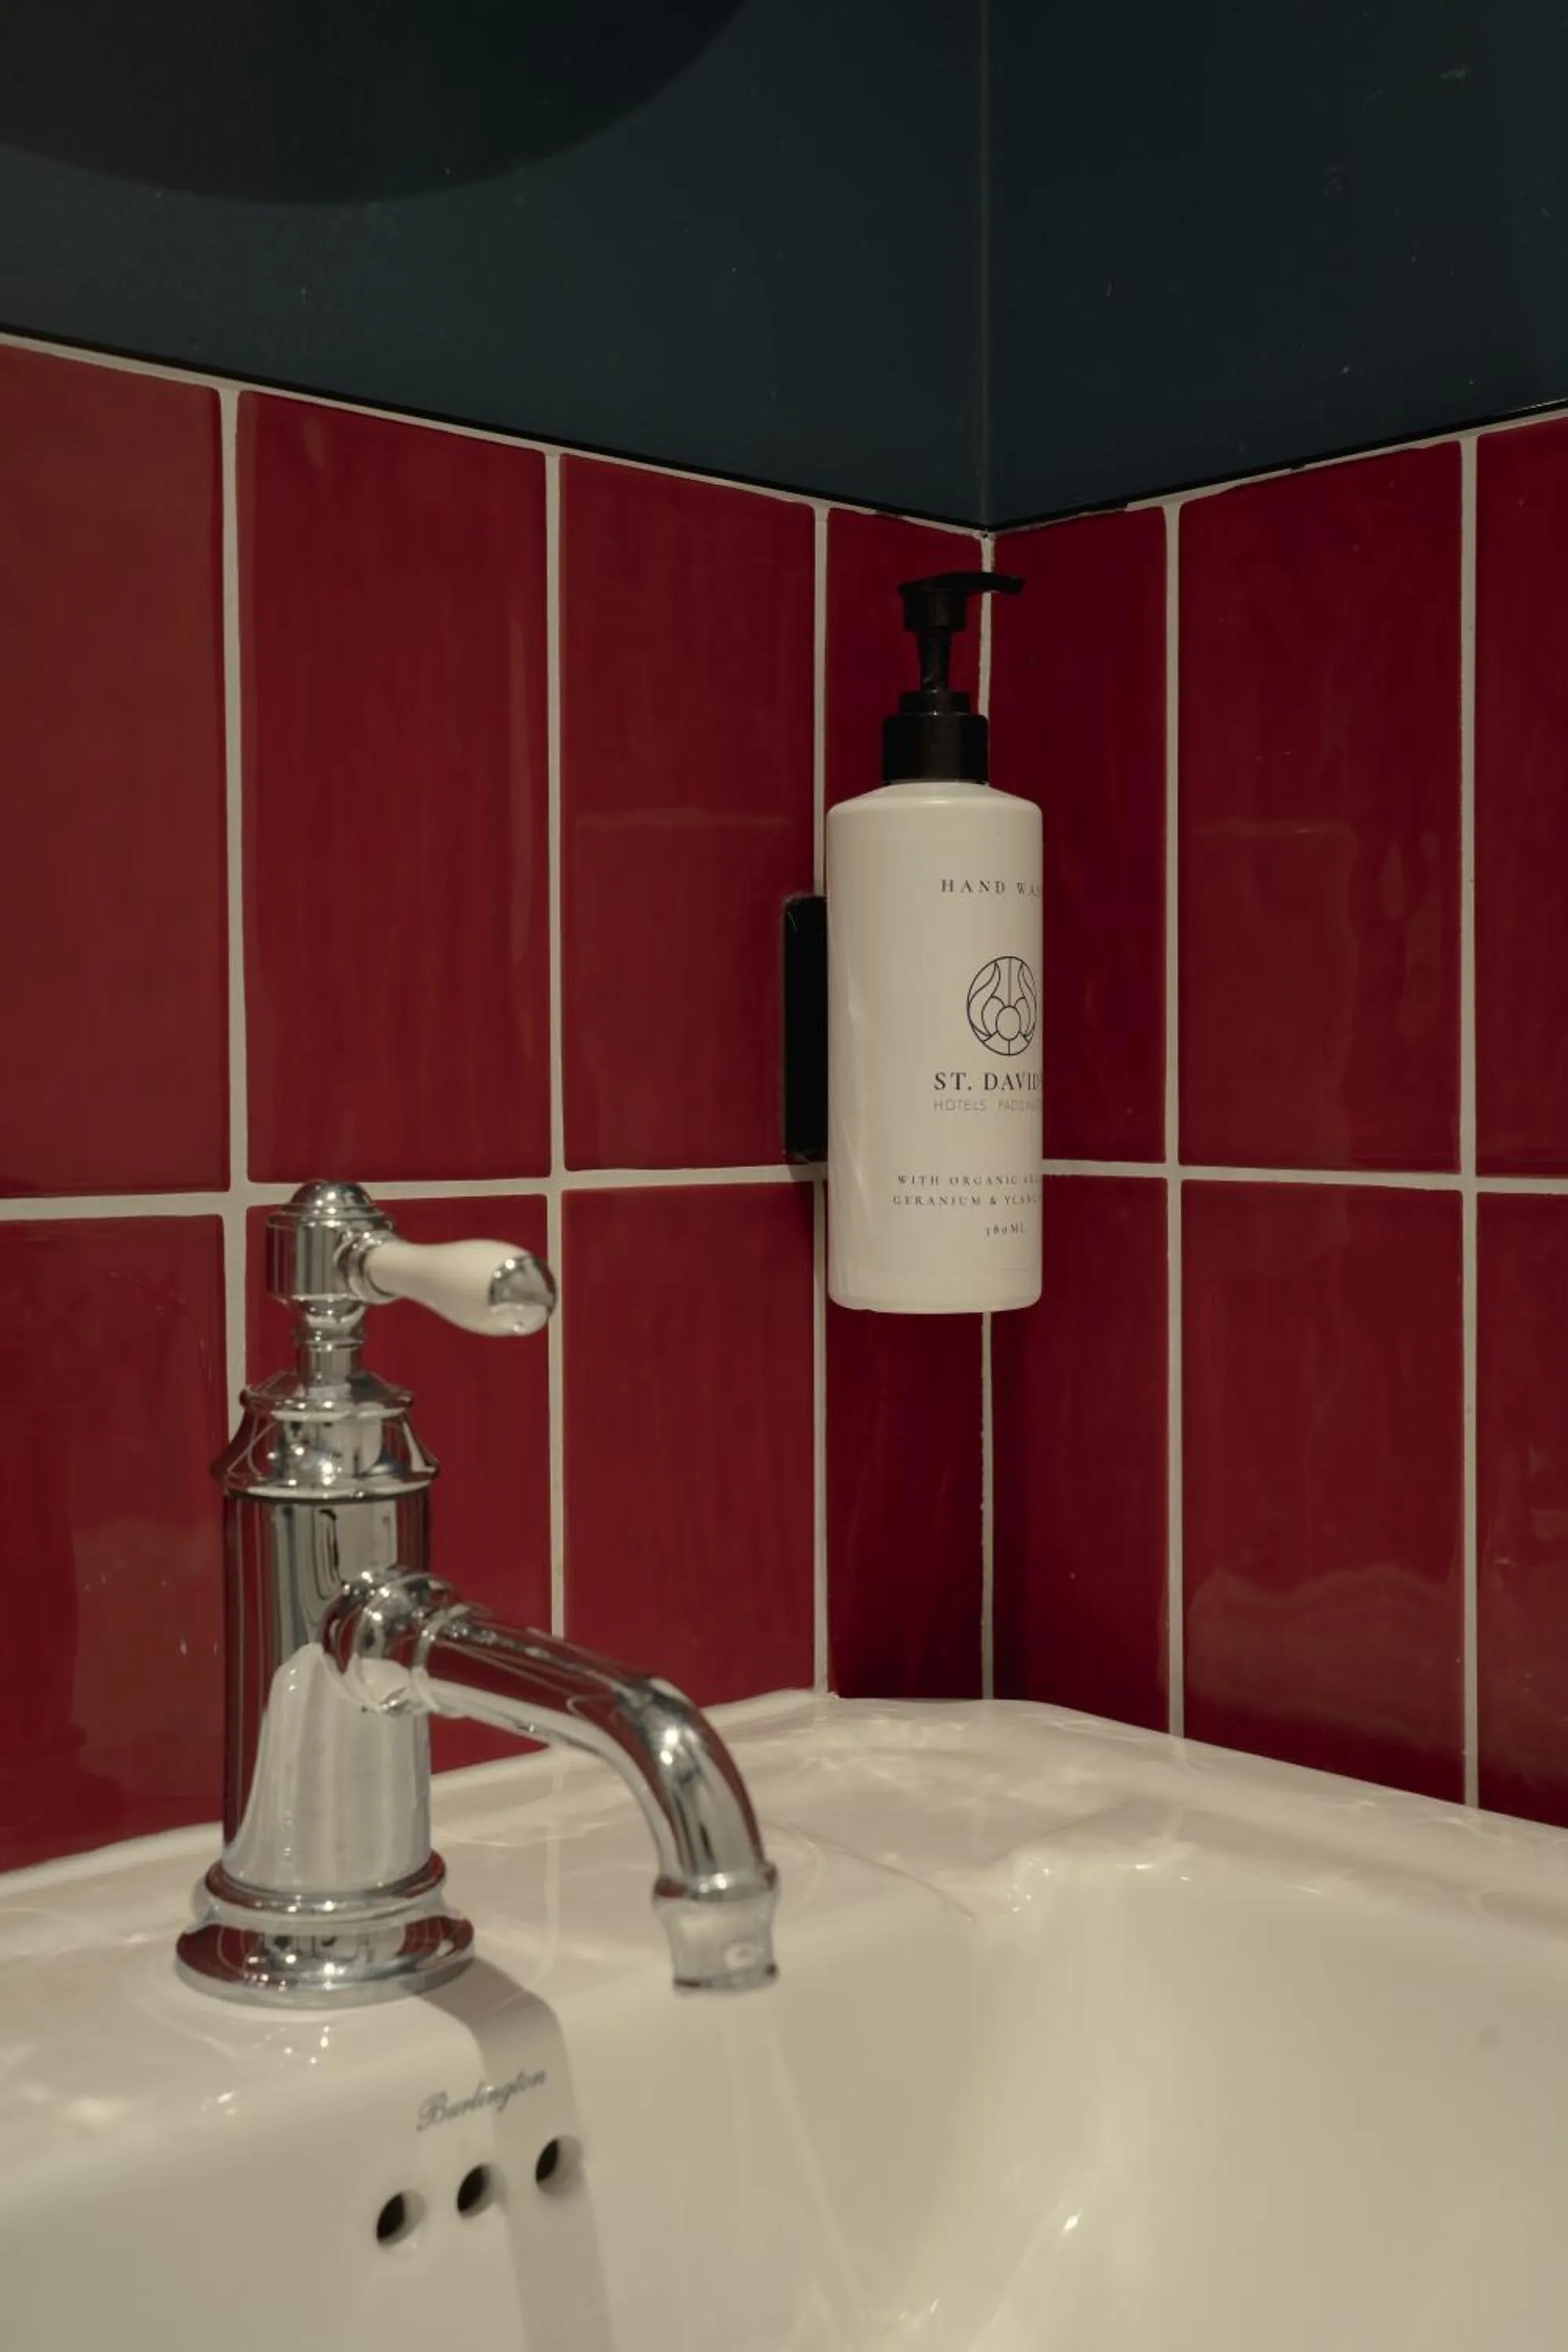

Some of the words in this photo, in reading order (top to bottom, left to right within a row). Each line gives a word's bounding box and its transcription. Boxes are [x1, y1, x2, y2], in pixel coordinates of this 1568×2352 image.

[941, 879, 1006, 895] HAND
[934, 1071, 972, 1091] ST.
[983, 1071, 1042, 1091] DAVID
[934, 1098, 988, 1112] HOTELS
[898, 1174, 939, 1186] WITH
[949, 1174, 1018, 1187] ORGANIC
[892, 1195, 982, 1206] GERANIUM
[989, 1194, 997, 1205] &
[416, 2070, 547, 2132] Burlington
